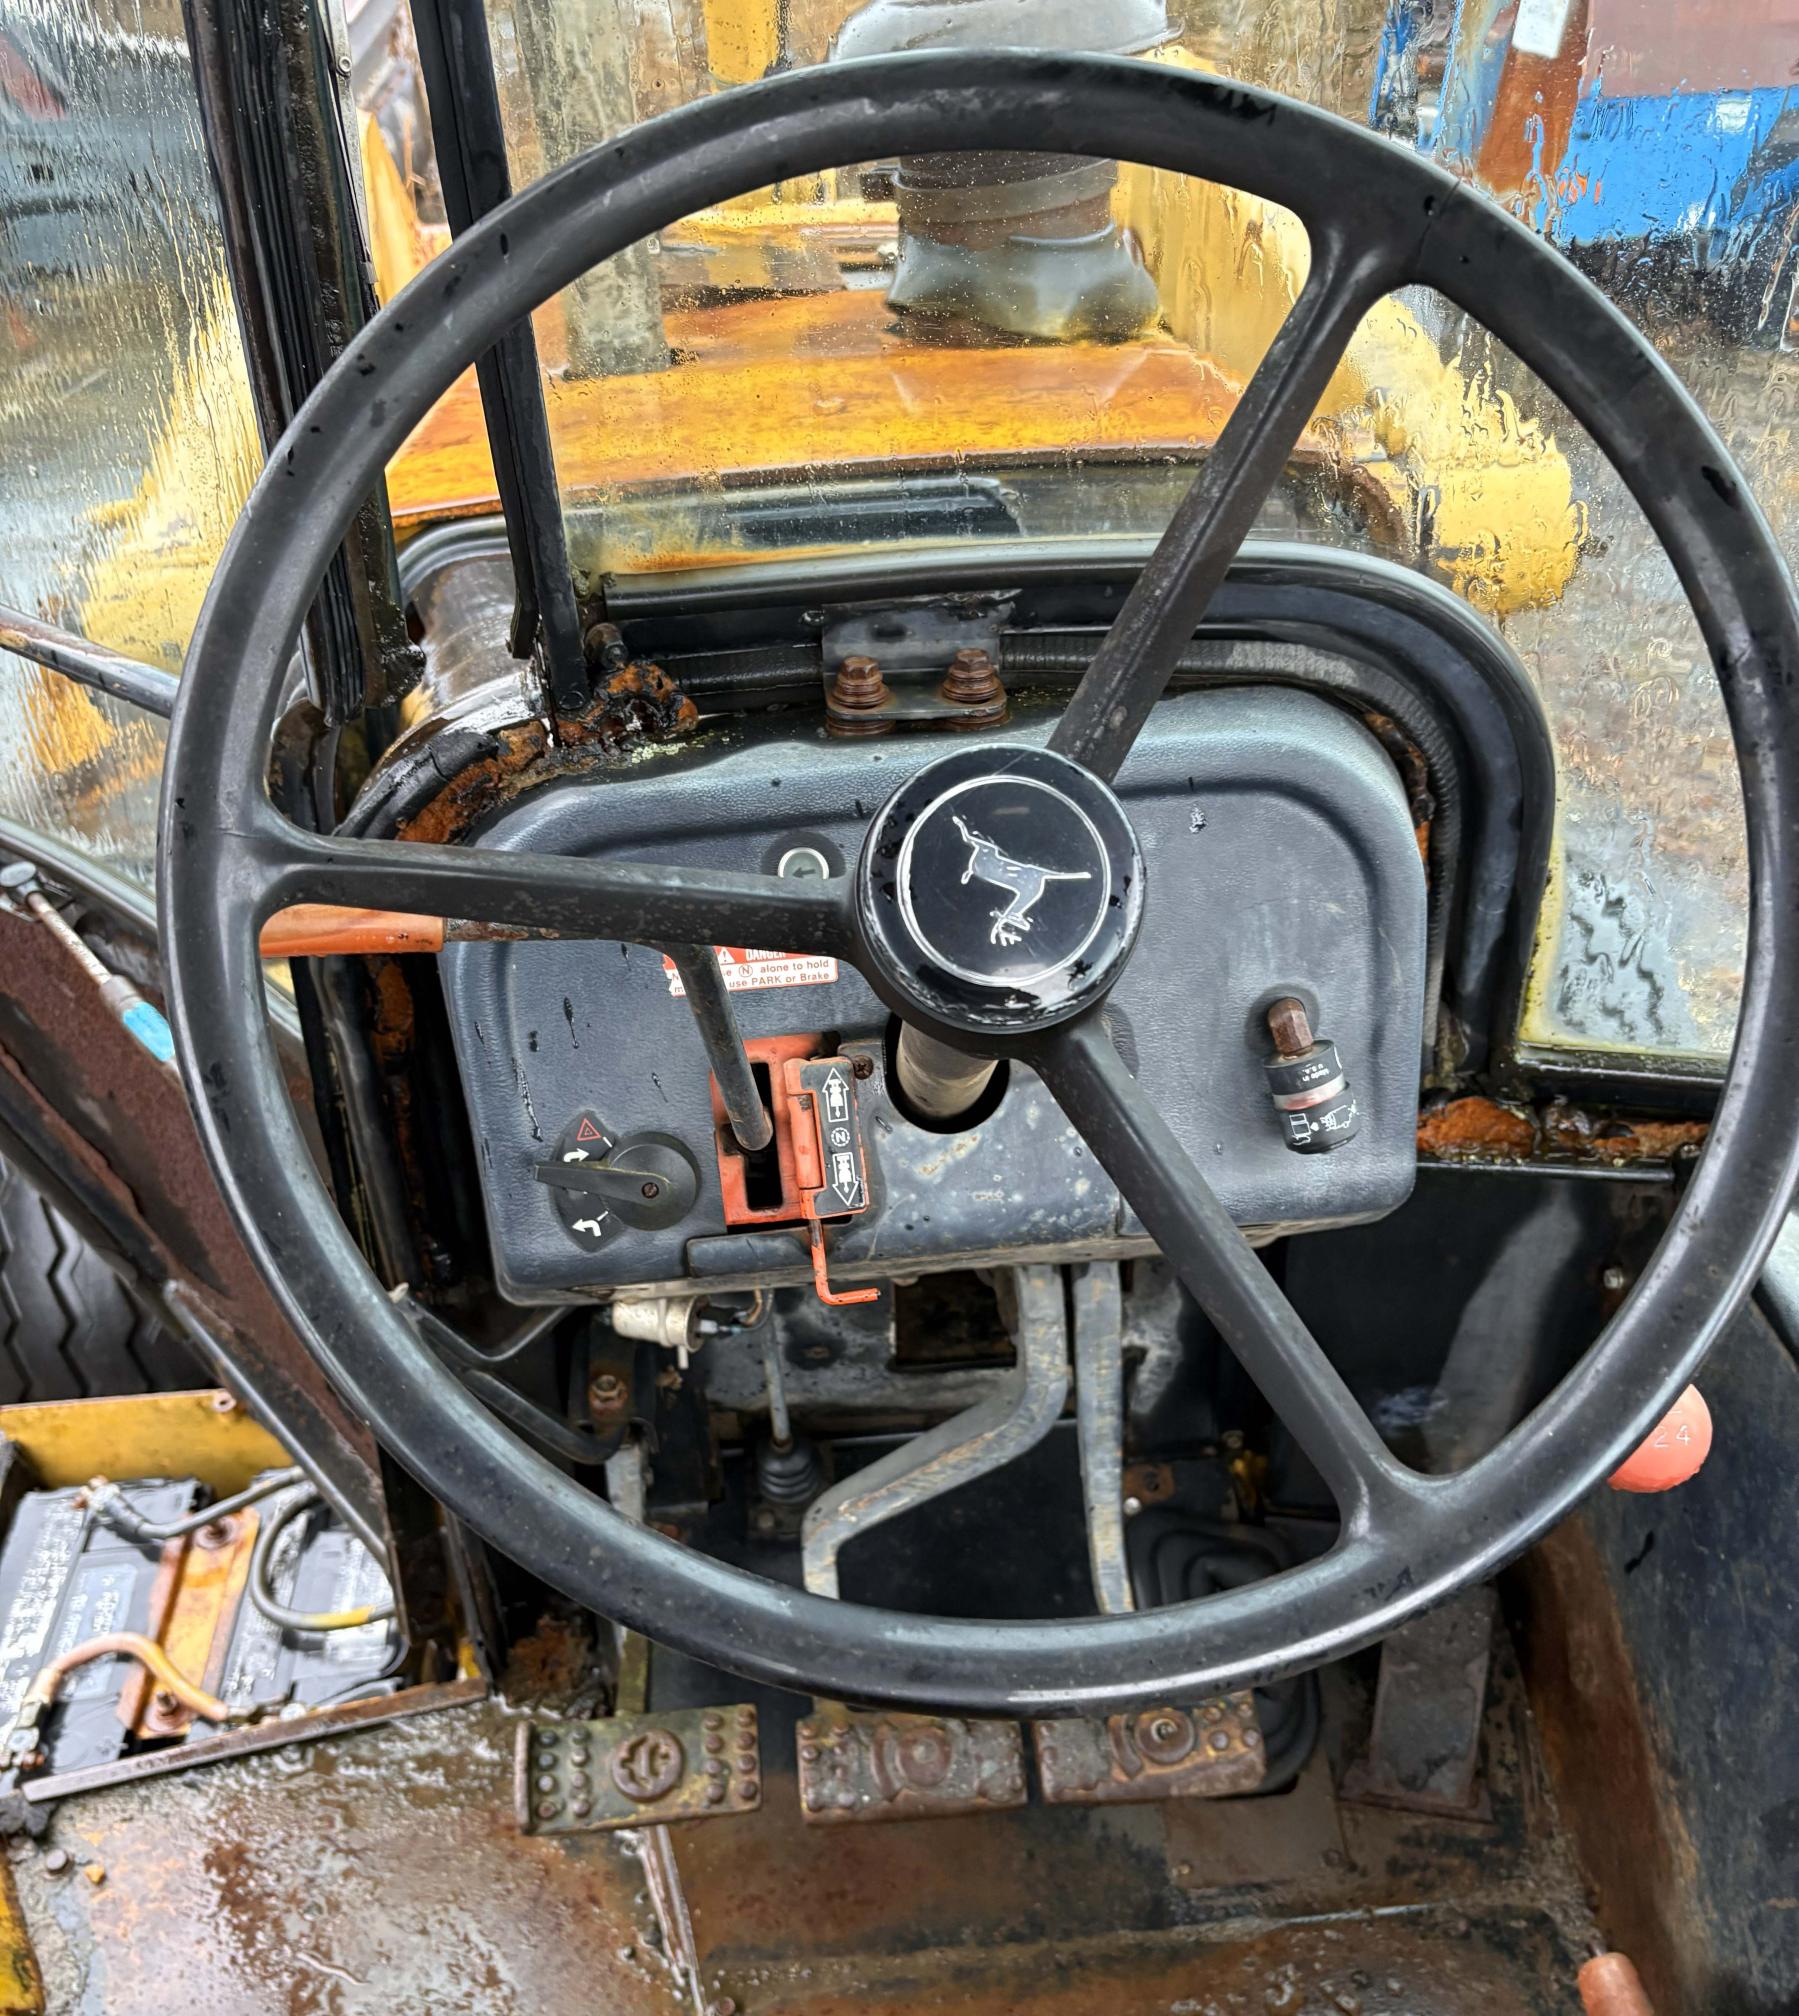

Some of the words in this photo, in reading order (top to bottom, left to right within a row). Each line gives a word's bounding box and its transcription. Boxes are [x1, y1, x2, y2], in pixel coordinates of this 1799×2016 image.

[760, 964, 789, 973] alone
[792, 962, 803, 971] to
[806, 959, 829, 969] hold
[729, 979, 747, 988] use
[751, 976, 781, 986] PARK
[785, 975, 796, 983] or
[800, 973, 830, 982] Brake
[835, 1132, 846, 1143] N
[1676, 1425, 1690, 1446] 4
